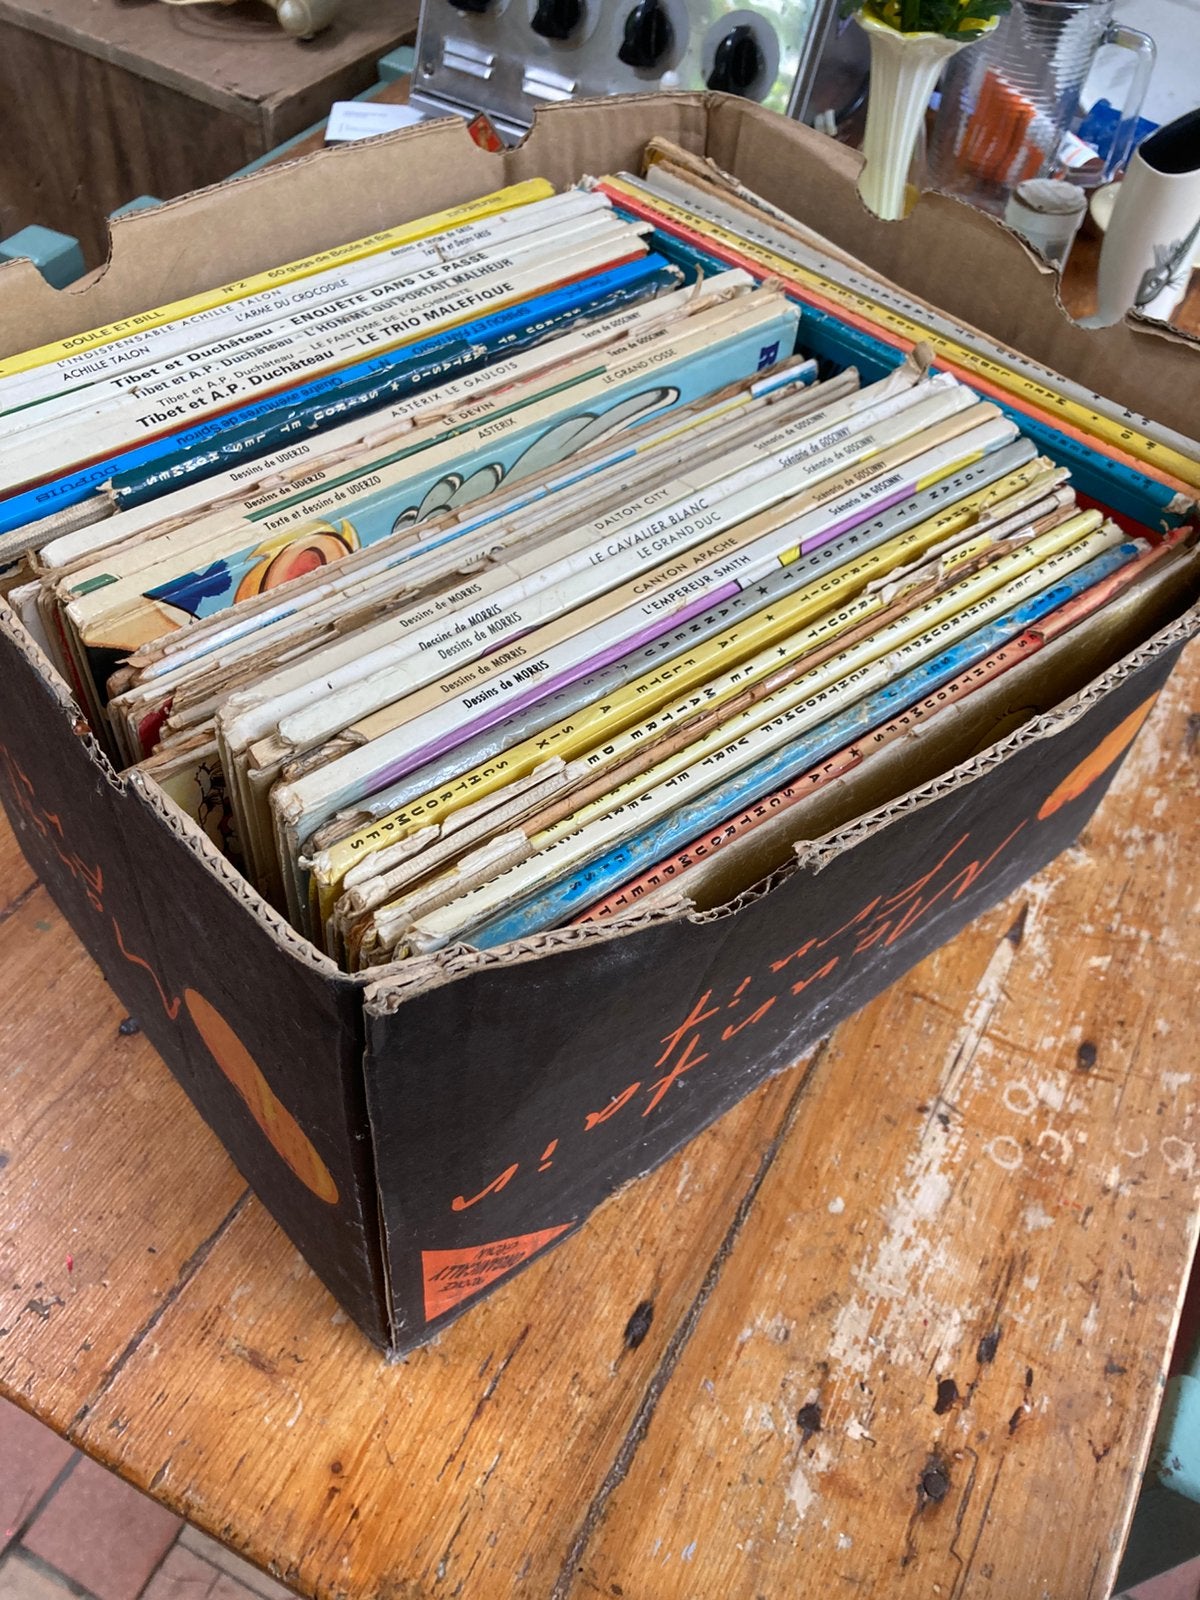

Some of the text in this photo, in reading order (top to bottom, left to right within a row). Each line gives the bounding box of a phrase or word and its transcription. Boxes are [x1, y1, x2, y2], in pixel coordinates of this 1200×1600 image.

[57, 288, 282, 368] L'INDISPENSABLE ACHILLE TALON
[62, 328, 110, 349] BOULE
[114, 321, 131, 332] ET
[133, 311, 165, 325] BILL
[268, 268, 285, 278] 60
[63, 278, 350, 381] ACHILLE TALON L'ARME DU CROCODILE
[110, 368, 160, 388] Tibet
[164, 359, 184, 370] et
[187, 327, 273, 362] Duchâteau
[371, 278, 416, 297] DANS
[418, 269, 439, 281] LE
[131, 258, 514, 400] Tibet et A.P. Duchâteau L'HOMME QUI PORTAIT MALHEUR
[496, 332, 517, 345] ET
[136, 405, 187, 428] Tibet
[187, 397, 208, 410] et
[210, 383, 246, 401] A.P.
[247, 348, 334, 386] Duchâteau
[356, 331, 380, 346] LE
[381, 315, 421, 337] TRIO
[156, 392, 190, 407] Tibet
[191, 386, 205, 395] et
[233, 352, 294, 379] Duchâteau
[309, 341, 326, 350] LE
[384, 314, 398, 323] DE
[229, 465, 264, 481] Dessins
[264, 460, 274, 469] de
[275, 445, 311, 463] UDERZO
[445, 385, 461, 396] LE
[463, 362, 519, 387] GAULOIS
[611, 311, 641, 329] GOSCINNY
[298, 374, 343, 399] Quatre
[959, 349, 1067, 406] MARC LEBUT
[175, 421, 222, 448] Spirou
[219, 414, 240, 430] de
[237, 391, 300, 422] aventures
[262, 359, 648, 531] Texte et dessins de UDERZO ASTERIX LE GRAND
[278, 419, 302, 434] ET
[34, 463, 120, 504] DUPUIS
[244, 492, 278, 510] Dessins
[279, 485, 291, 496] de
[290, 471, 326, 490] UDERZO
[442, 414, 457, 426] LE
[460, 401, 496, 420] DEVIN
[400, 608, 434, 628] Dessins
[435, 601, 447, 611] de
[447, 583, 482, 604] MORRIS
[593, 503, 643, 530] DALTON
[643, 488, 670, 505] CITY
[795, 411, 828, 430] GOSCINNY
[437, 638, 473, 660] Dessins
[474, 630, 487, 643] de
[487, 611, 522, 635] MORRIS
[636, 546, 652, 560] LE
[652, 525, 695, 551] GRAND
[695, 511, 723, 531] DUC
[844, 434, 877, 455] GOSCINNY
[454, 622, 467, 634] de
[467, 603, 502, 627] MORRIS
[589, 554, 604, 567] LE
[606, 519, 668, 557] CAVALIER
[669, 498, 710, 525] BLANC
[820, 426, 851, 447] GOSCINNY
[642, 464, 985, 658] JOHAN ET PIRLOUIT L'ANNEAU
[440, 671, 476, 693] Dessins
[477, 663, 491, 675] de
[491, 645, 527, 668] MORRIS
[633, 563, 688, 595] CANYON
[692, 537, 739, 564] APACHE
[855, 460, 887, 482] GOSCINNY
[462, 686, 499, 710] Dessins
[499, 677, 513, 690] de
[513, 660, 550, 683] MORRIS
[641, 574, 714, 615] L'EMPEREUR
[714, 554, 751, 578] SMITH
[859, 489, 872, 500] de
[870, 474, 904, 495] GOSCINNY
[798, 554, 880, 604] PIRLOUIT
[920, 573, 981, 612] JOHAN
[717, 633, 739, 649] LA
[886, 614, 910, 632] ET
[586, 664, 755, 765] LE MAITRE DE
[598, 703, 612, 714] A
[635, 656, 696, 695] FLUTE
[872, 649, 1007, 744] SCHTROUMPFS
[535, 724, 574, 751] SIX
[598, 667, 870, 827] SCHTROUMPF VERT ET VERT
[808, 761, 835, 783] LA
[349, 758, 509, 852] SCHTROUMPFS
